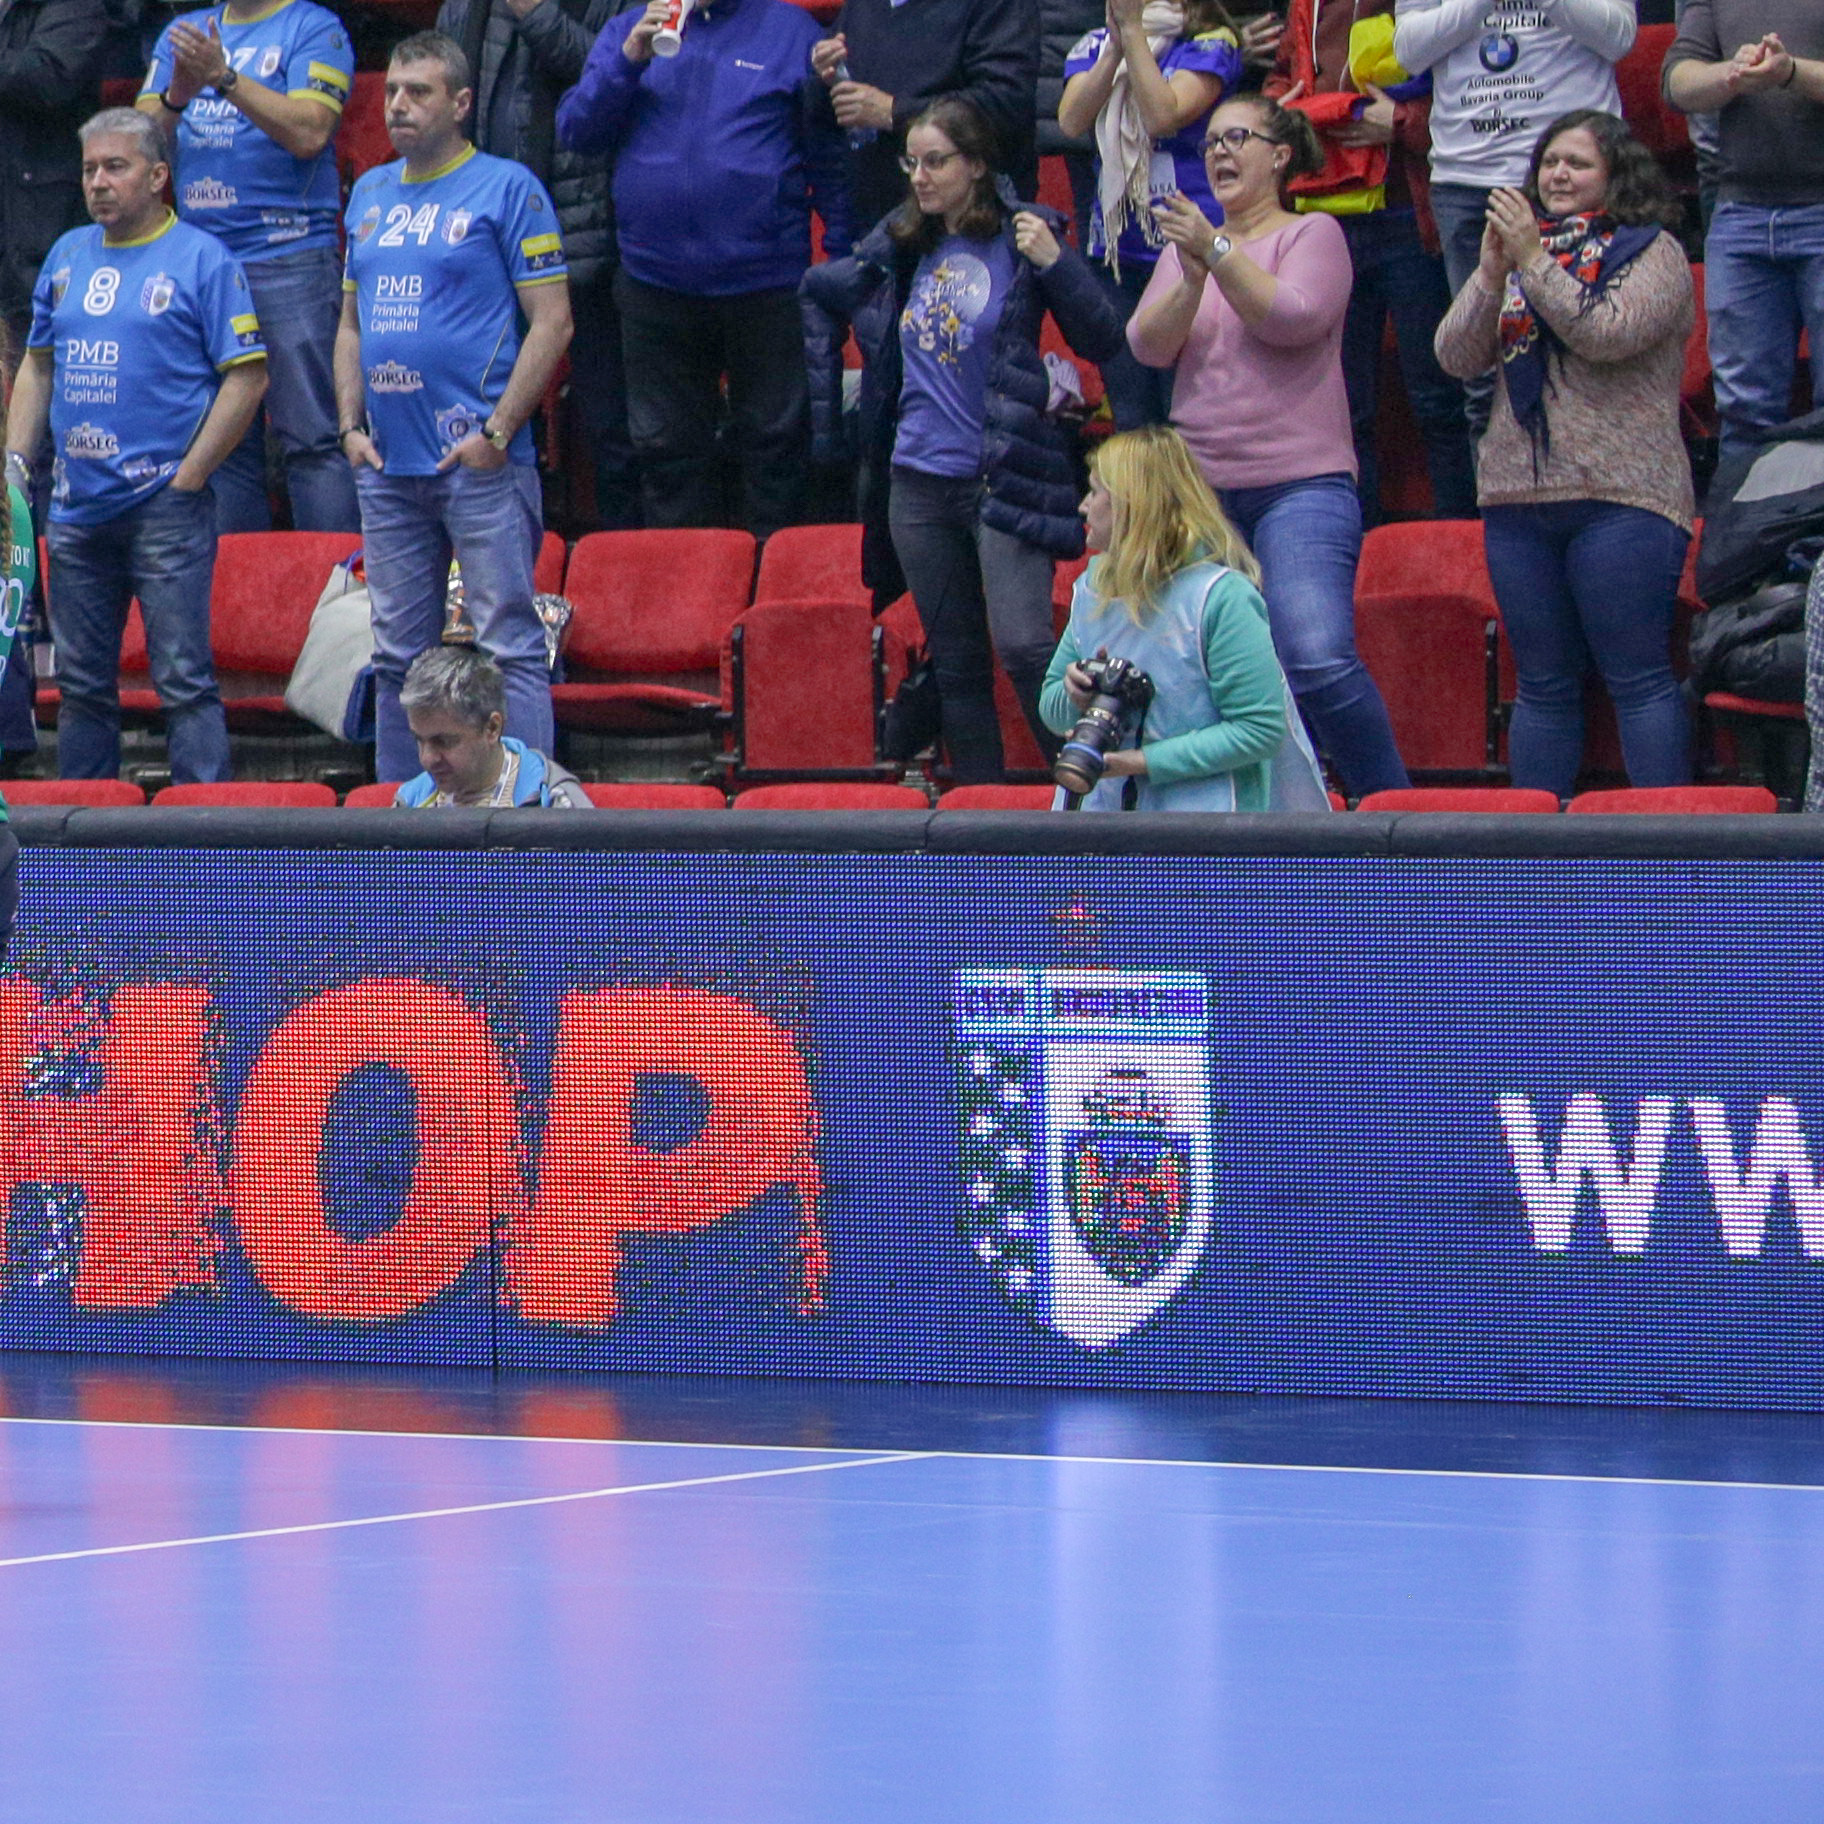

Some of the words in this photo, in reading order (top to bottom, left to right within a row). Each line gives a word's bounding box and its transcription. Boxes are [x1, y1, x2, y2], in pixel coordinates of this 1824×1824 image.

[1503, 89, 1545, 103] Group
[378, 203, 440, 247] 24
[83, 266, 121, 317] 8
[375, 274, 423, 297] PMB
[65, 339, 120, 365] PMB
[64, 387, 117, 406] Capitalei
